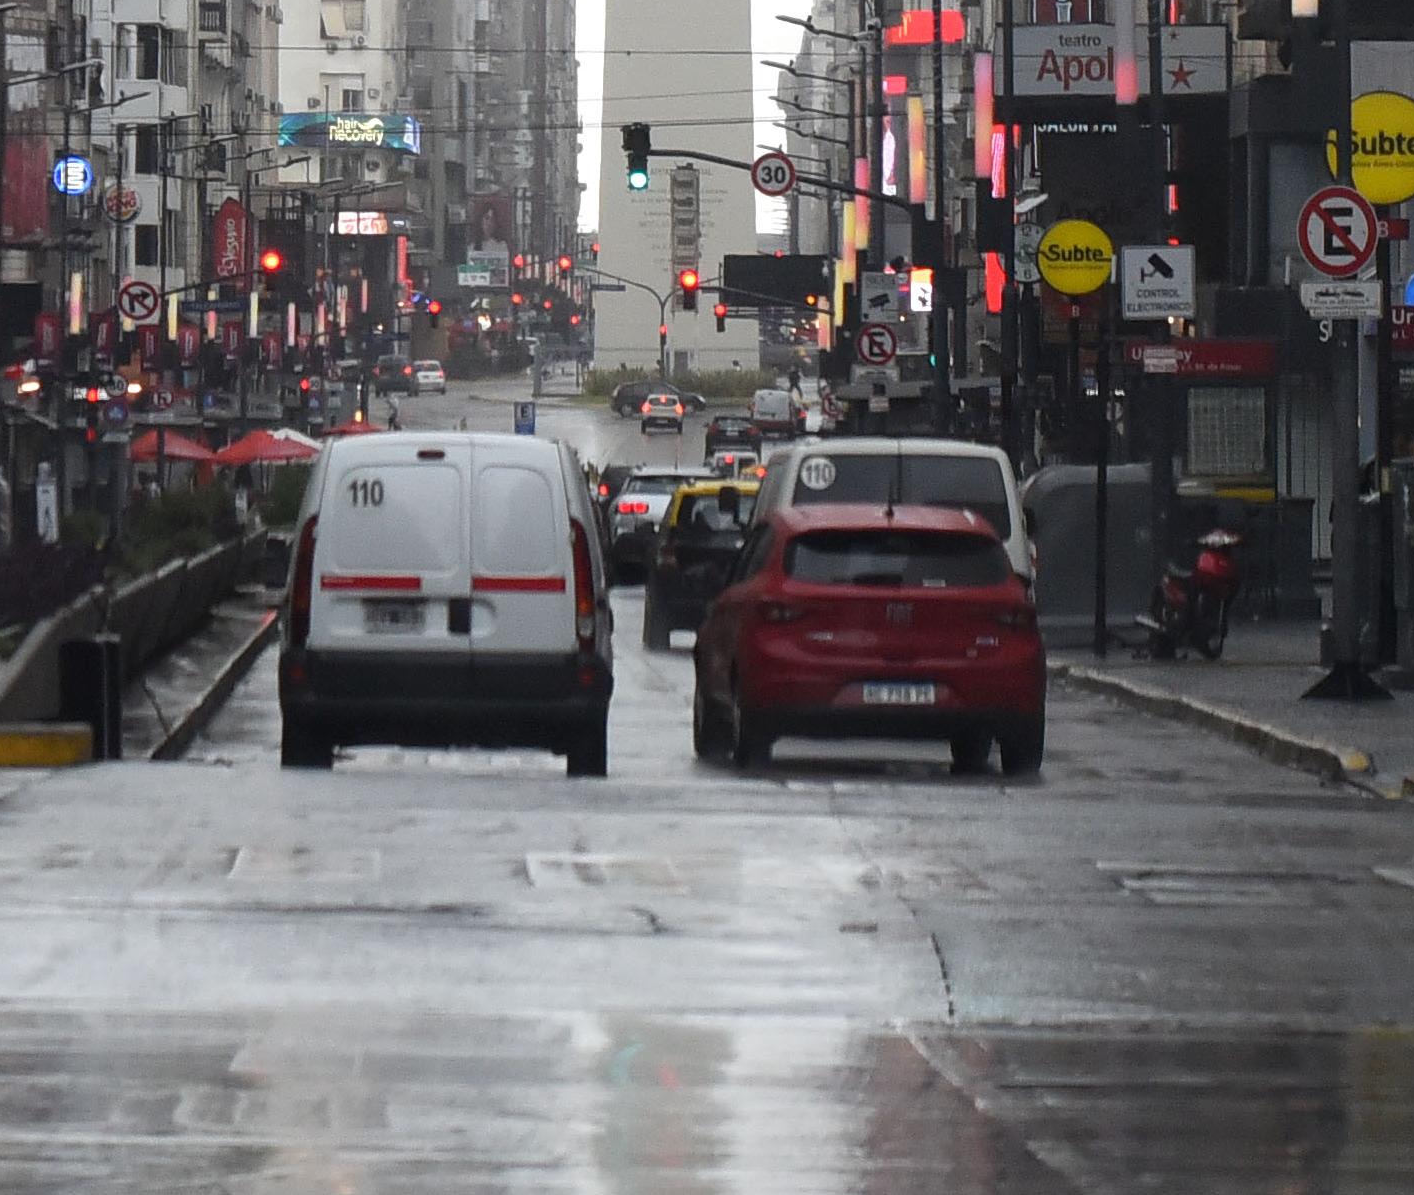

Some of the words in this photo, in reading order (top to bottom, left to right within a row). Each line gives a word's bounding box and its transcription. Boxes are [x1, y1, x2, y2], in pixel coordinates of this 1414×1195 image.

[1059, 33, 1102, 48] teatro
[1036, 46, 1115, 92] Apol
[337, 116, 359, 130] hair
[761, 164, 787, 186] 30
[1047, 244, 1104, 262] Subte
[1136, 288, 1181, 299] CONTROL
[806, 463, 833, 485] 110
[349, 479, 385, 507] 110
